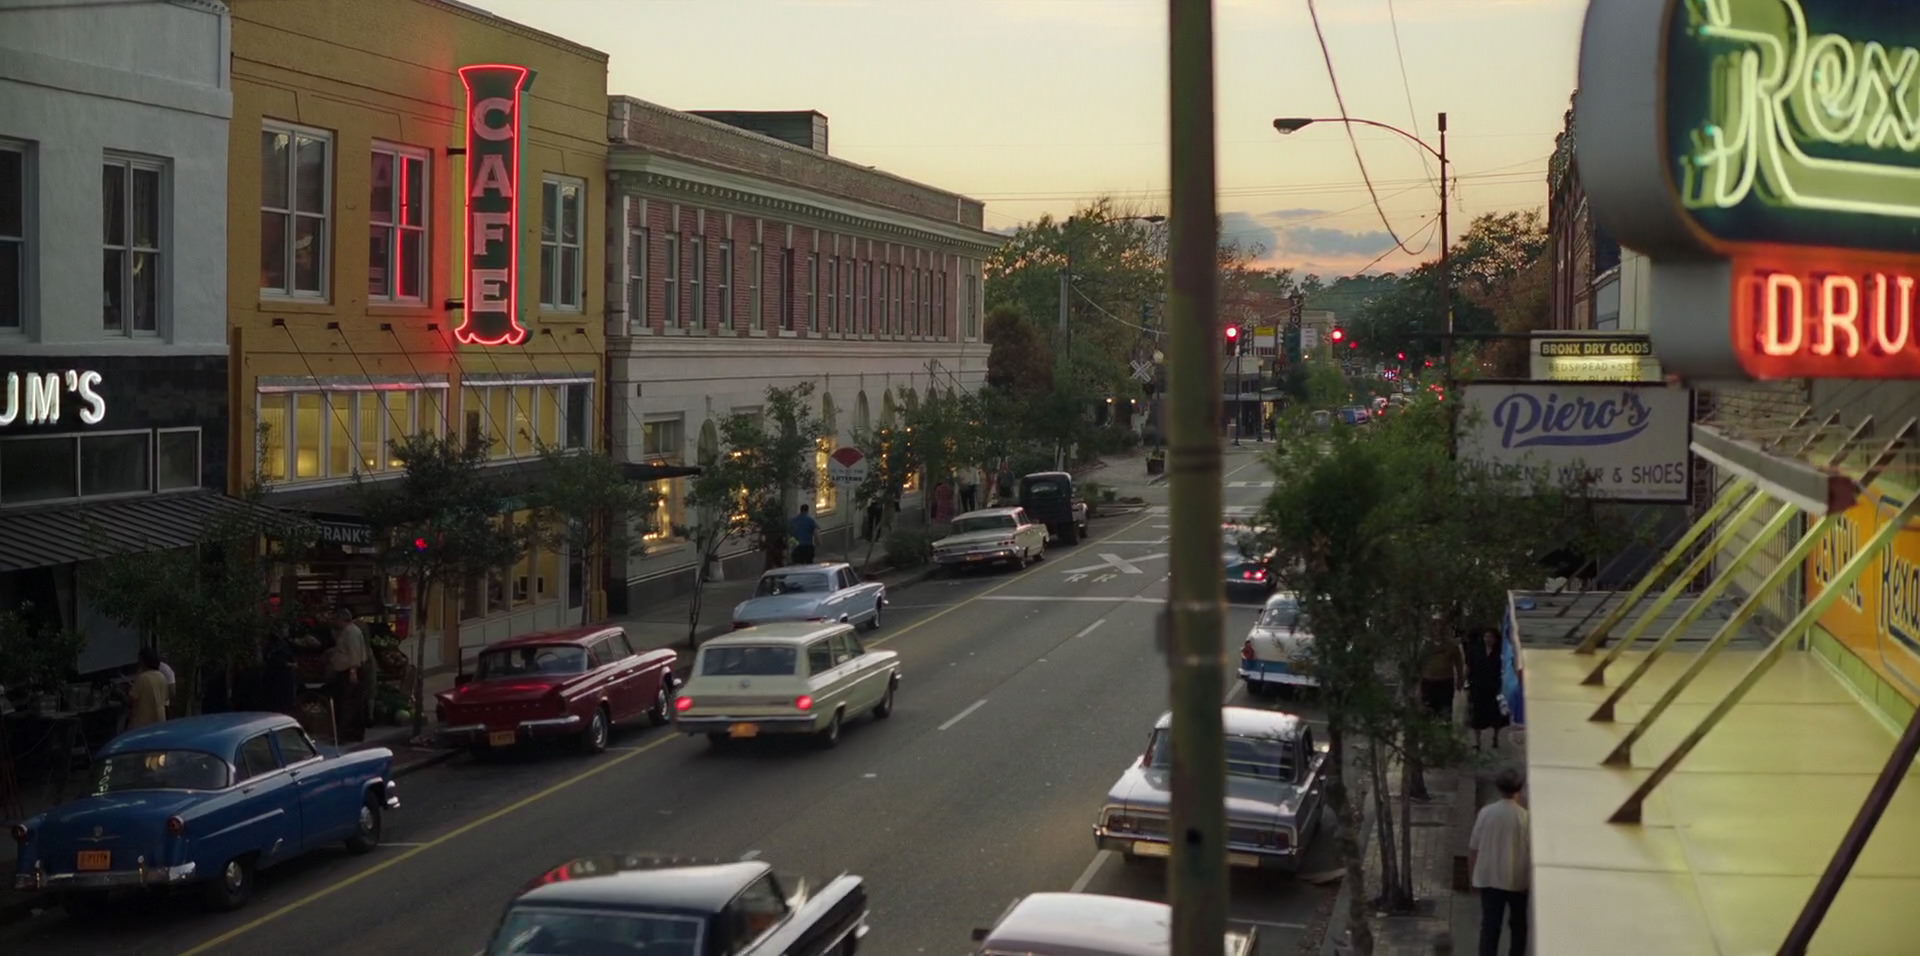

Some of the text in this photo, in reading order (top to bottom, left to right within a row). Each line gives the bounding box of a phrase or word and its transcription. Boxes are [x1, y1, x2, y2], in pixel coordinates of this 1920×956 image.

[471, 96, 515, 314] CAFE
[1753, 271, 1917, 358] DRU
[1541, 341, 1650, 356] BRONX DRY GOODS
[1547, 361, 1643, 373] BEDSPREAD SETS
[1492, 391, 1652, 450] Piero's
[1611, 467, 1623, 484] &
[1630, 462, 1685, 484] SHOES
